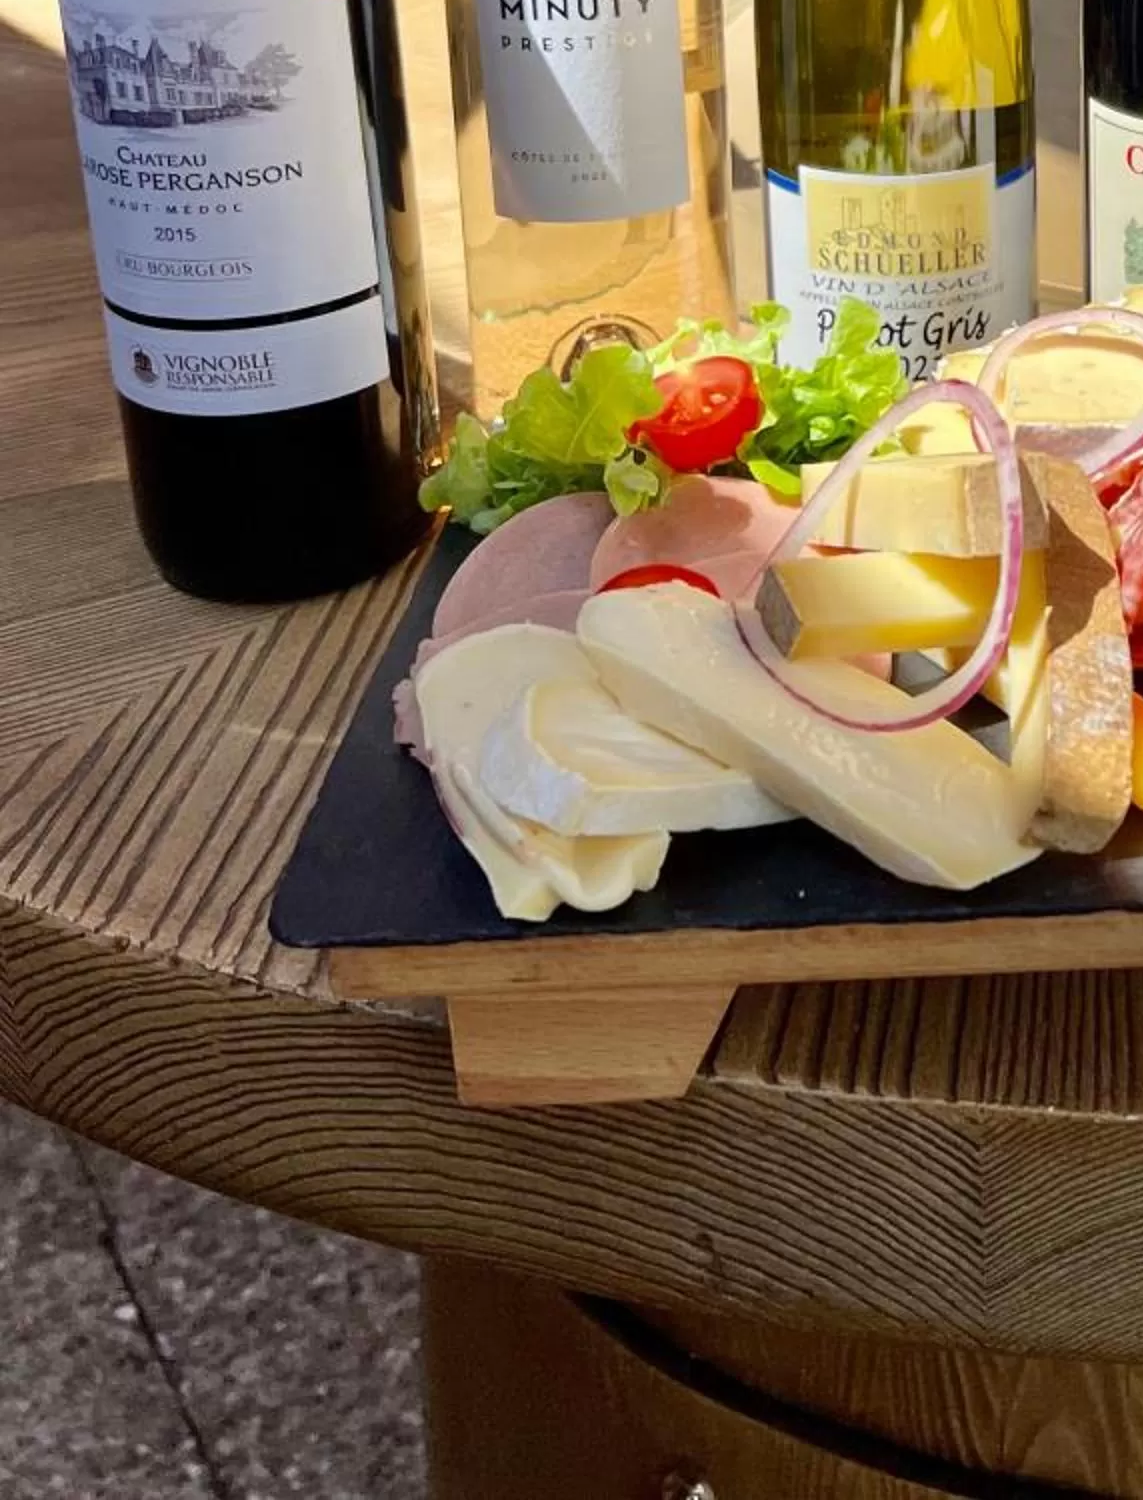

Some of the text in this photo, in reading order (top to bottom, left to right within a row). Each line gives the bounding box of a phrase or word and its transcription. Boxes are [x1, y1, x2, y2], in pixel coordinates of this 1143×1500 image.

[501, 32, 654, 52] PRESTG
[117, 145, 207, 168] CHATEAU
[137, 162, 304, 192] PERGANSON
[154, 227, 197, 242] 2015
[832, 227, 970, 250] EDMOND
[818, 243, 986, 276] SCHUELLER
[811, 274, 856, 293] VIN
[816, 306, 991, 350] Pot Gris
[162, 351, 275, 372] VIGNOBLE
